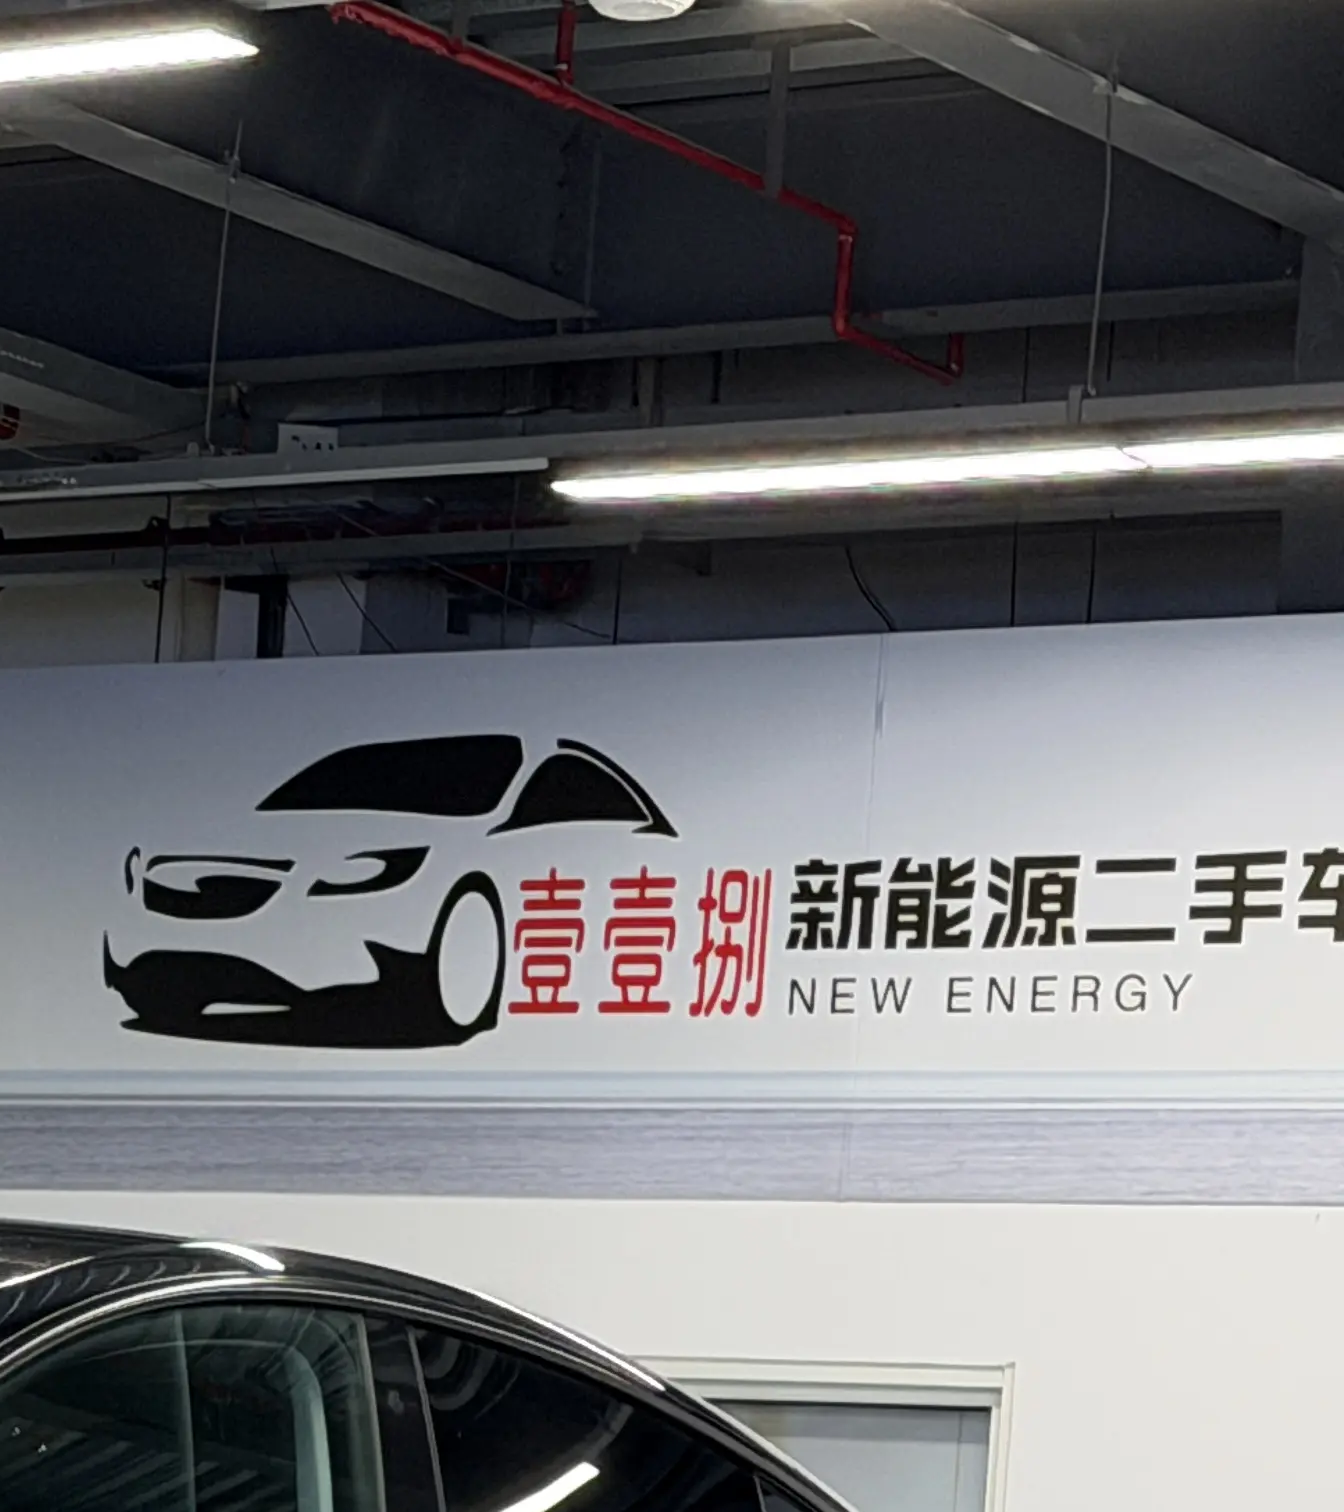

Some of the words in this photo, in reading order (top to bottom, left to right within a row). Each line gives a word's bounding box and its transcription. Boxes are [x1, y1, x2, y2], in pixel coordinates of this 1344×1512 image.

[507, 866, 772, 1017] 壹壹捌
[787, 974, 913, 1017] NEW
[946, 973, 1195, 1014] ENERGY
